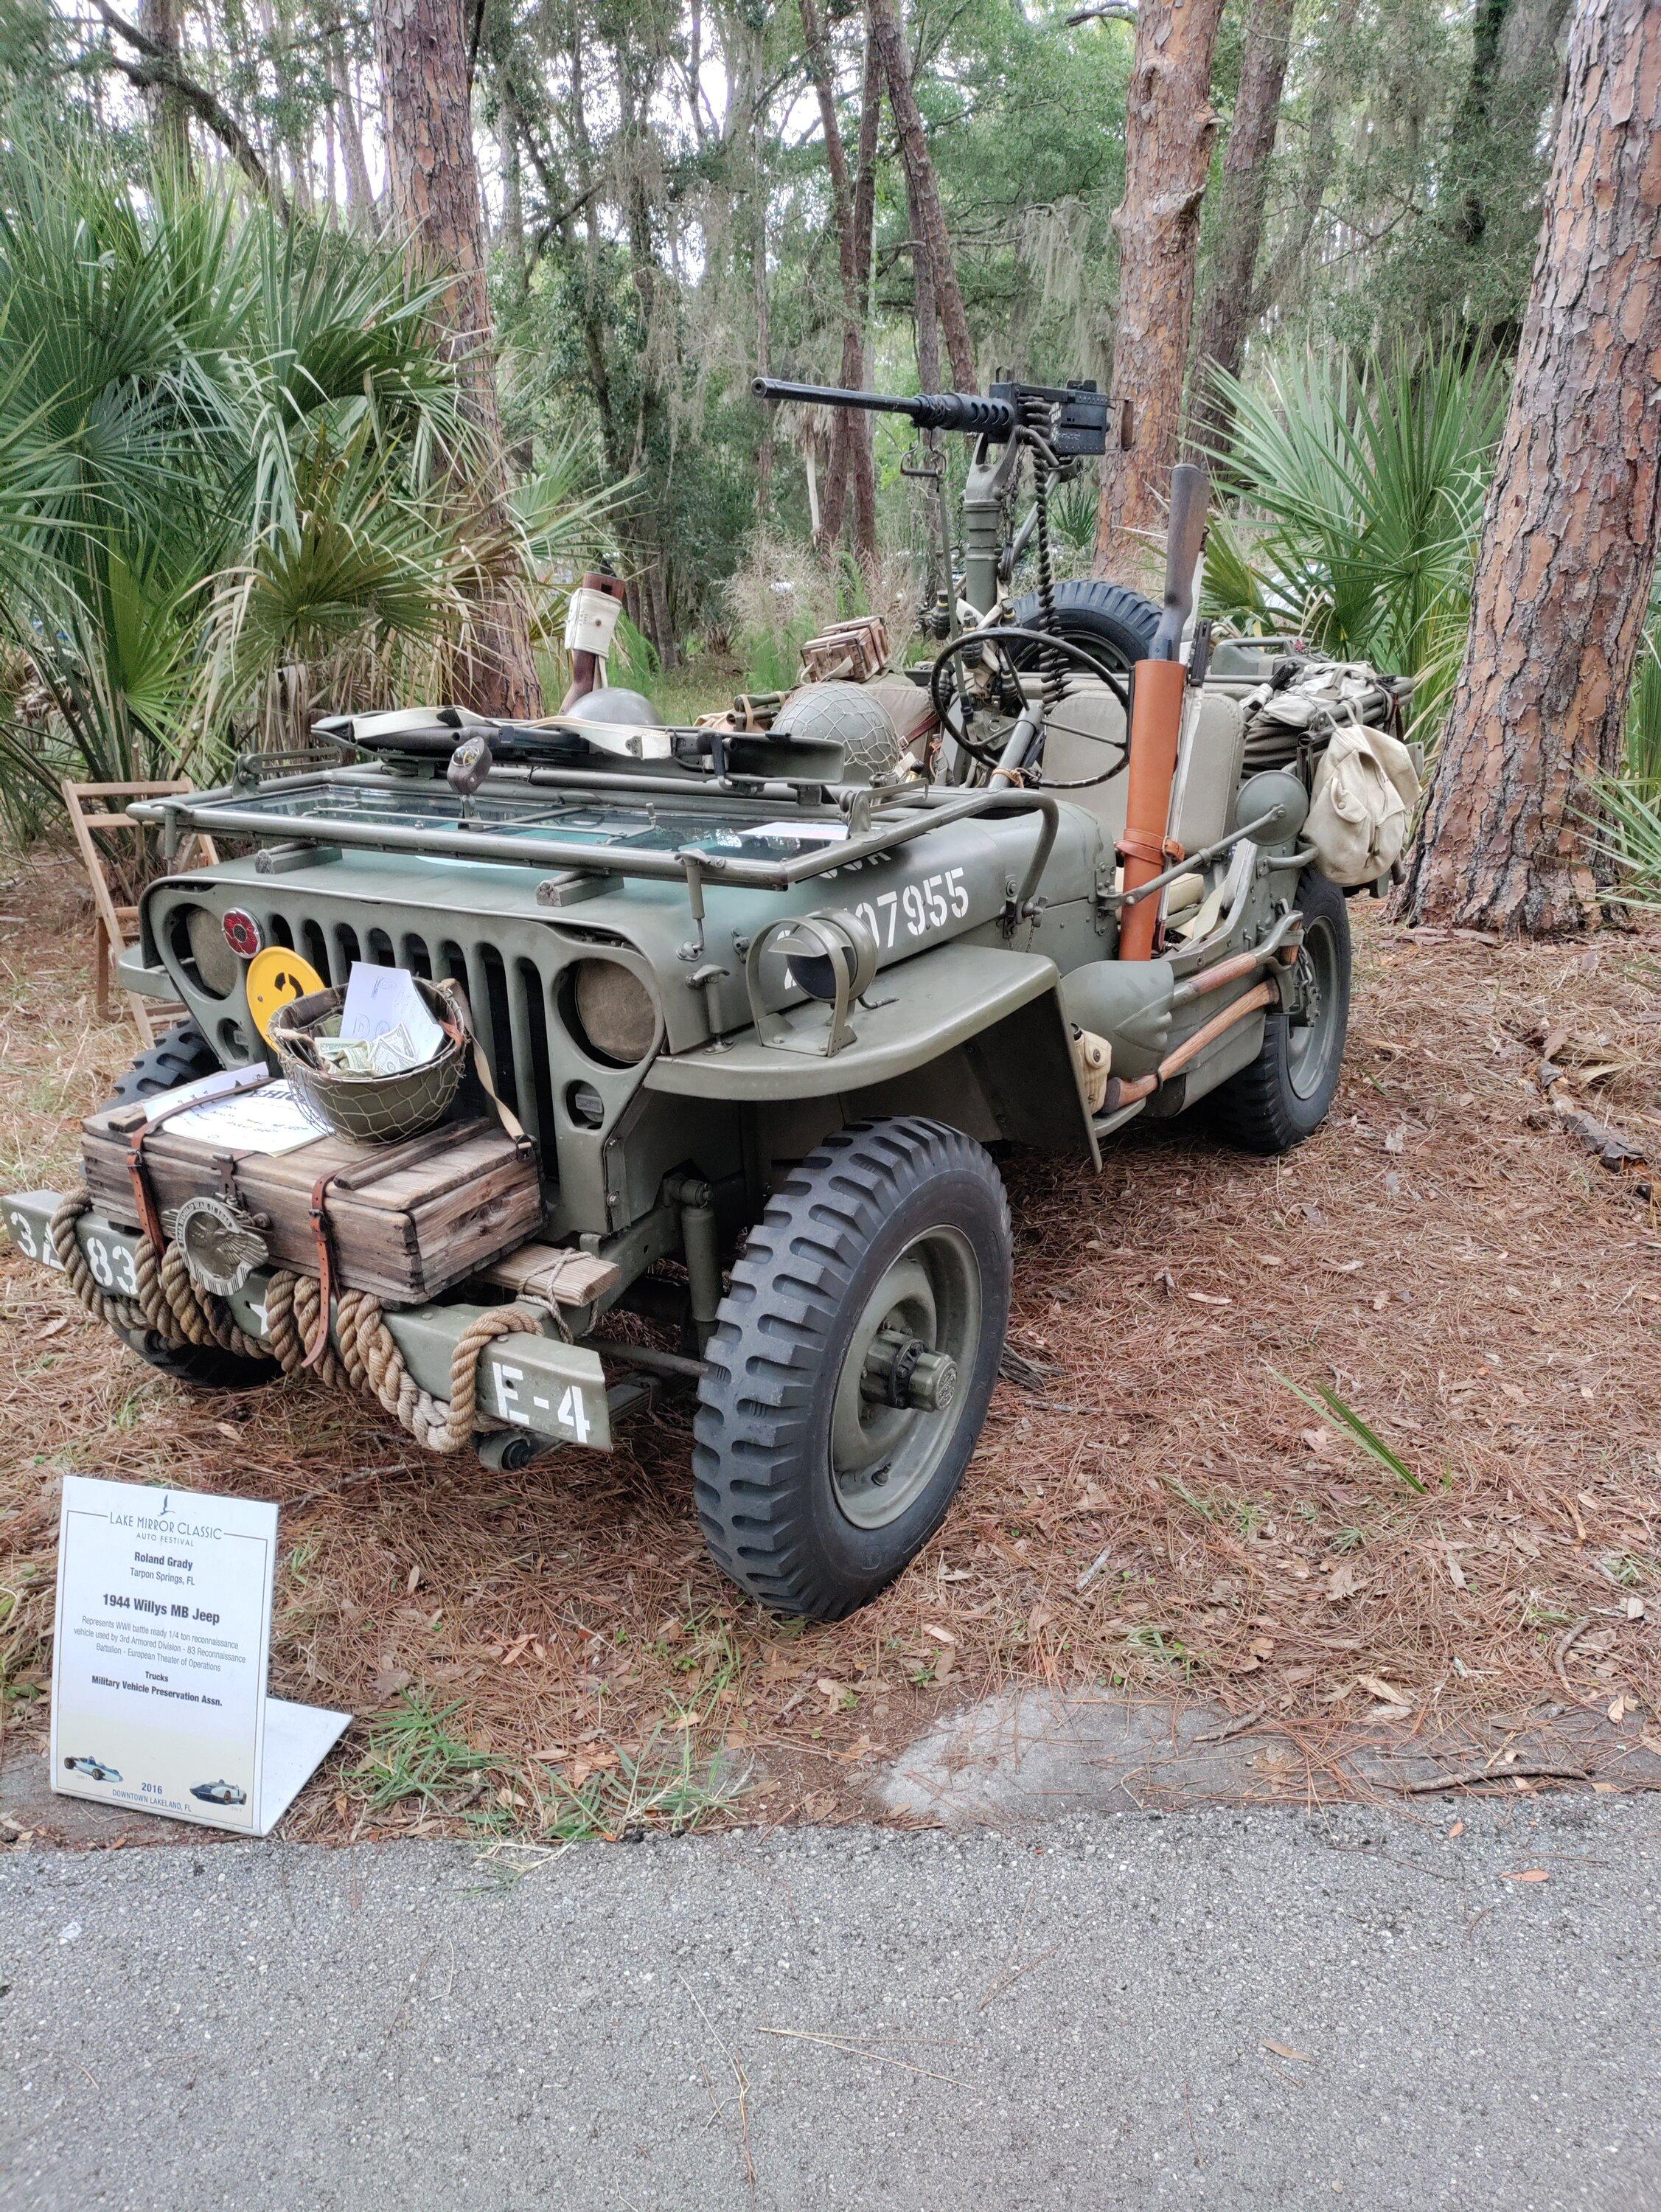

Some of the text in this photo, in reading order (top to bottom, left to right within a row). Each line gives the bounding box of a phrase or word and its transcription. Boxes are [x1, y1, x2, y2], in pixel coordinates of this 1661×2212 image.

[87, 1237, 139, 1295] 83
[492, 1362, 590, 1444] E-4
[110, 1512, 221, 1540] LAKE MIRROR CLASSIC
[136, 1532, 193, 1546] AUTO FESTIVAL
[135, 1551, 193, 1571] Roland Grady
[130, 1568, 195, 1585] Tarpon Springs, FL
[103, 1594, 220, 1625] 1944 Willys MB Jeep
[74, 1627, 94, 1637] vehicle
[96, 1631, 109, 1640] used
[111, 1634, 118, 1643] by
[131, 1637, 156, 1649] Armored
[158, 1641, 181, 1652] Division
[187, 1646, 195, 1655] 83
[197, 1648, 246, 1663] Reconnaissance
[83, 1615, 239, 1649] Represents WWII battle ready 1/4 ton reconnaissance
[96, 1643, 122, 1654] Battalion
[128, 1649, 155, 1661] European
[158, 1653, 179, 1665] Theater
[181, 1658, 187, 1666] of
[189, 1659, 221, 1672] Operations
[91, 1675, 223, 1706] Military Vehicle Preservation Assn.
[145, 1671, 168, 1683] Trucks
[113, 1789, 192, 1812] DOWNTOWN LAKELAND, FL
[142, 1782, 162, 1795] 2016
